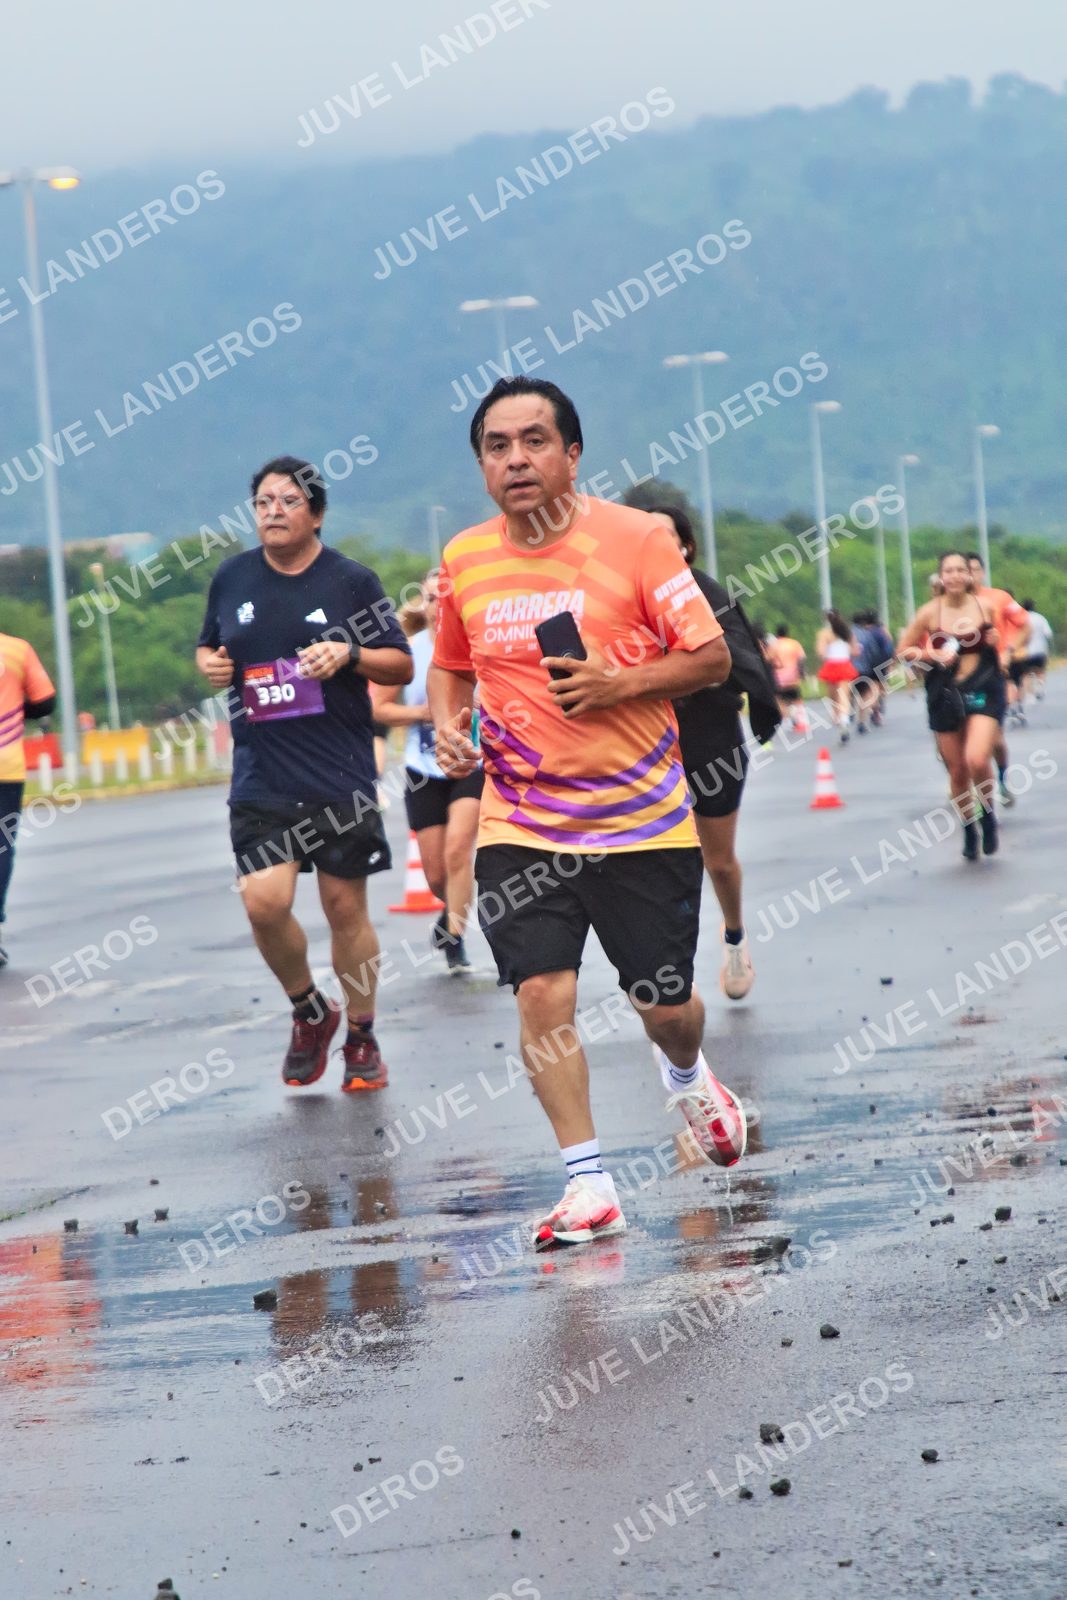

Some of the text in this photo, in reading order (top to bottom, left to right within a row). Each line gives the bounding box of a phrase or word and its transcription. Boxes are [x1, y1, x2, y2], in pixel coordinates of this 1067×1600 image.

[485, 589, 584, 625] CARRERA
[484, 623, 537, 644] OMNIL
[257, 683, 295, 706] 330
